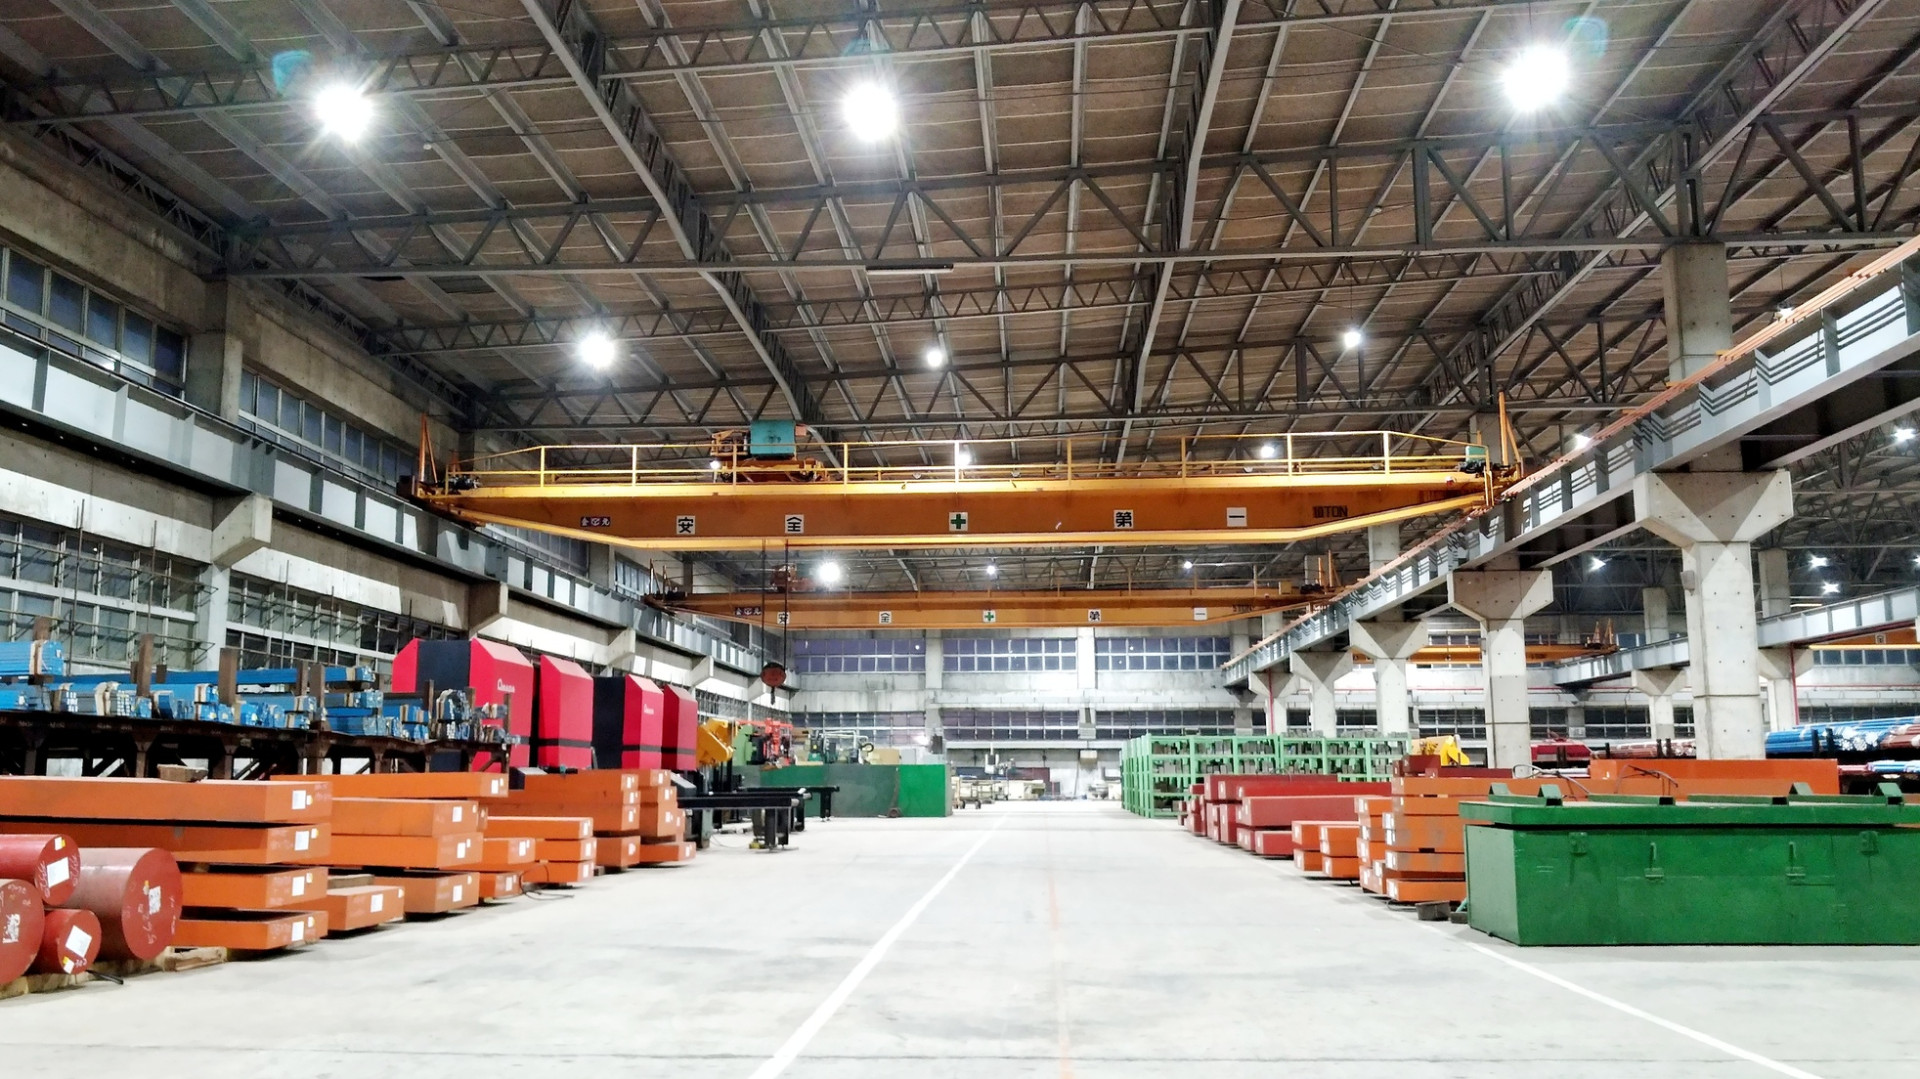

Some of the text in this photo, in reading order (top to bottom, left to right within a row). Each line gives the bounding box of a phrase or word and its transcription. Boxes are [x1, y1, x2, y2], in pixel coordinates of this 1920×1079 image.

[1313, 505, 1348, 518] 10TON
[678, 516, 694, 533] 安
[787, 516, 802, 532] 全
[1115, 511, 1132, 527] 第
